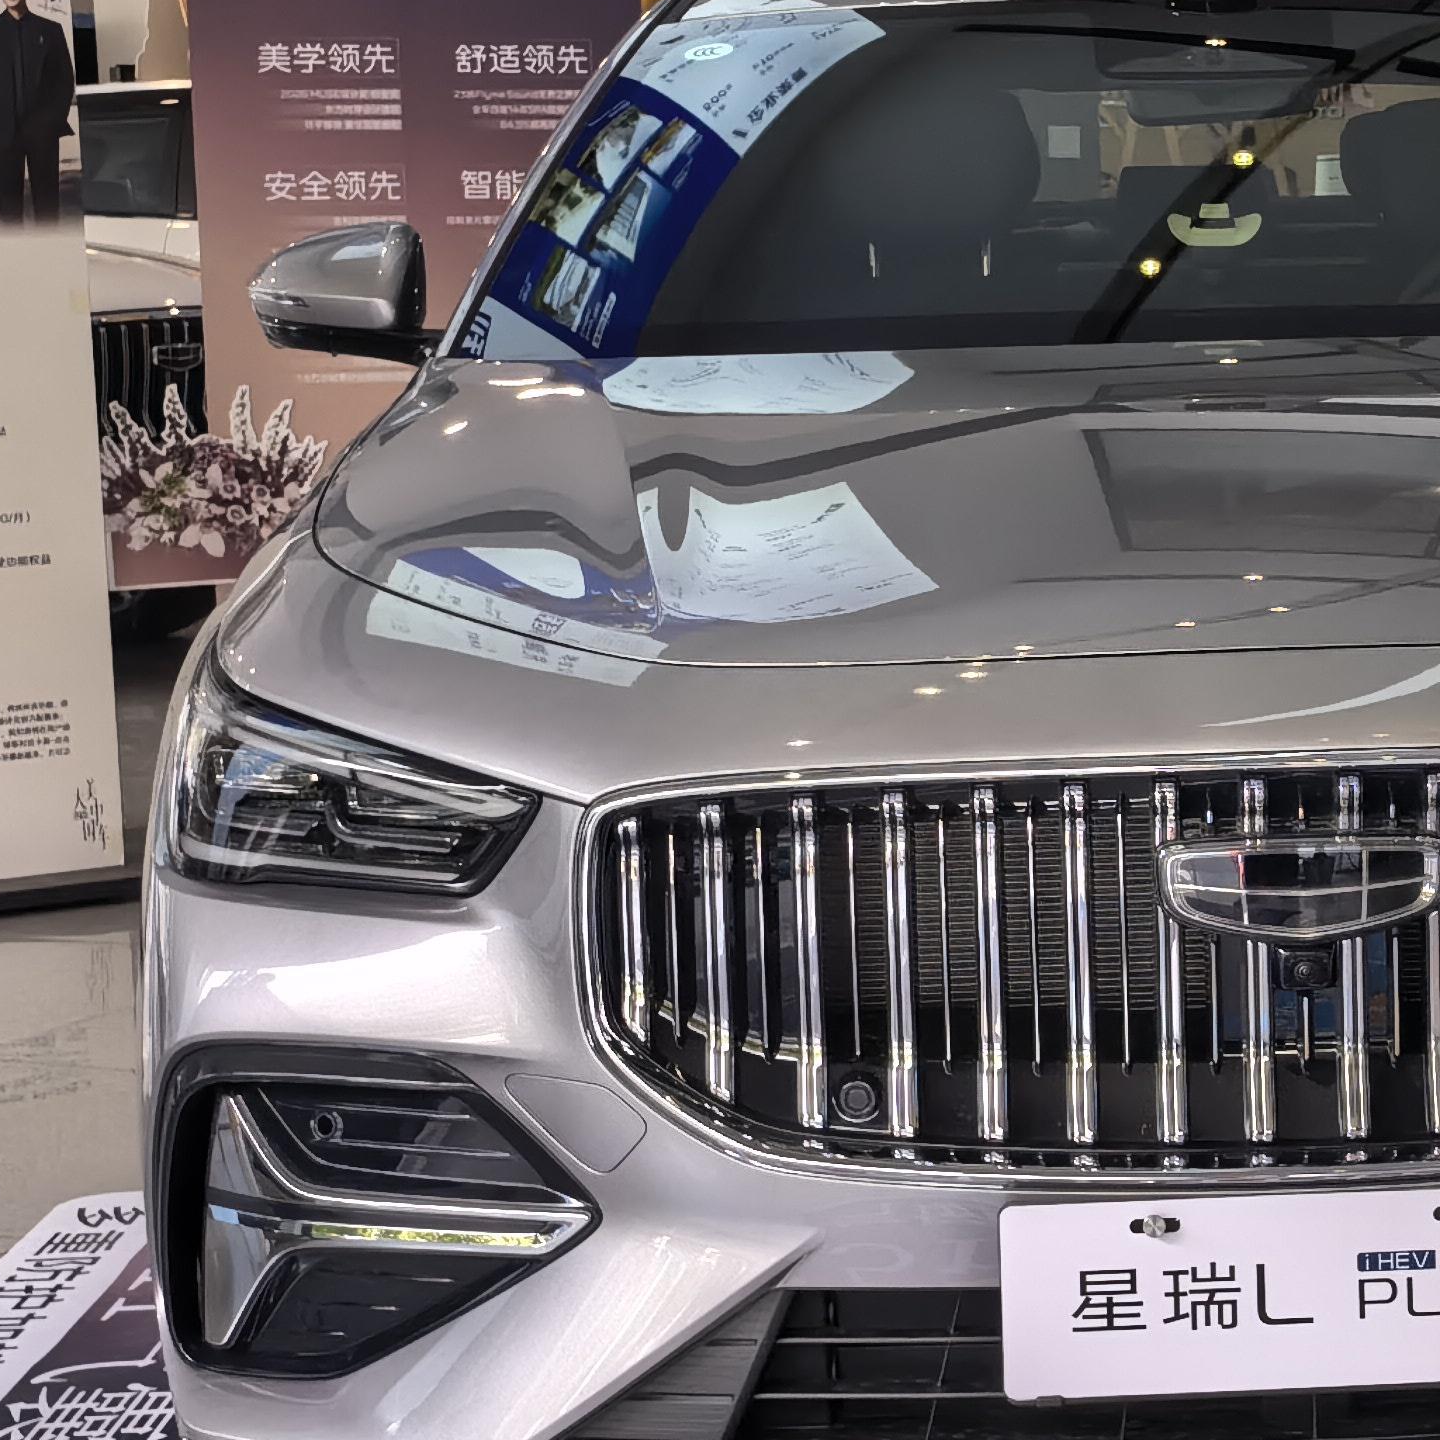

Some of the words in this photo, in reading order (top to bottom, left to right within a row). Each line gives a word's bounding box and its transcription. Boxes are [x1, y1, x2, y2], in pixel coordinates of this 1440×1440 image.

[257, 42, 396, 75] 美学领先
[455, 44, 590, 76] 舒适领先
[263, 170, 402, 201] 安全领先
[1070, 1262, 1315, 1333] 星瑞L
